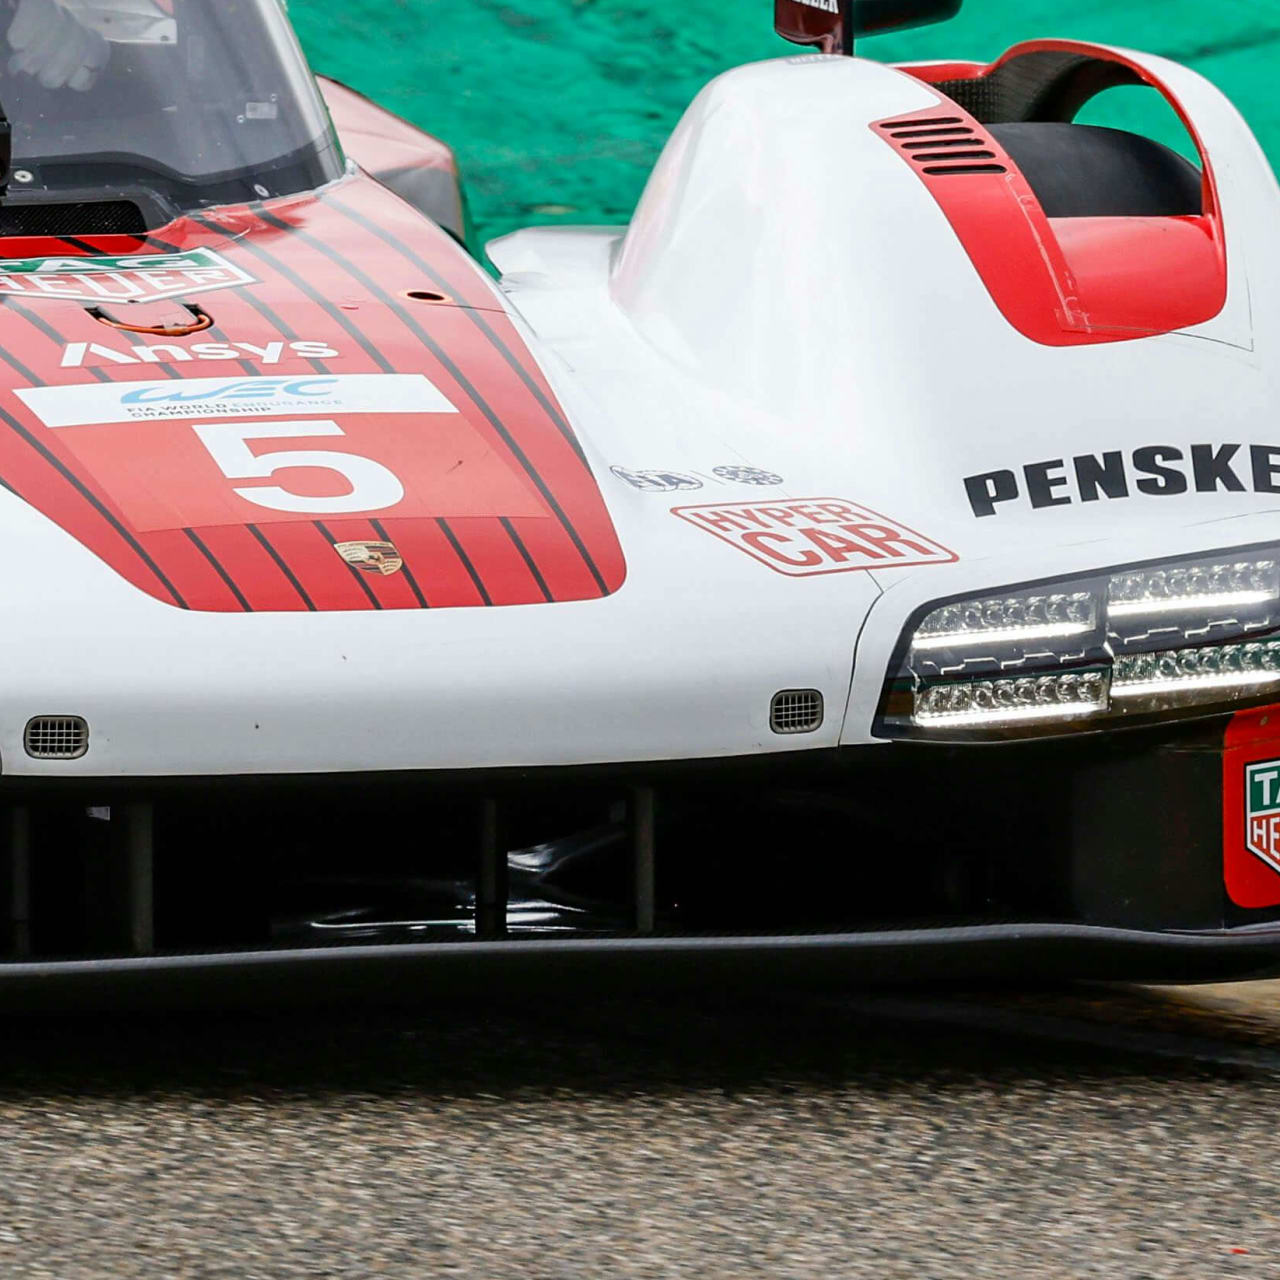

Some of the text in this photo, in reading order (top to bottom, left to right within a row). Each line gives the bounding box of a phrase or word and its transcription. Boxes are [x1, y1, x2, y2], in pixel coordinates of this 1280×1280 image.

[59, 341, 340, 368] Ansys
[120, 378, 339, 404] WEC
[131, 406, 272, 418] CHAMPIONSHIP
[160, 402, 228, 411] WORLD
[191, 420, 405, 514] 5
[692, 502, 871, 533] HYPER
[741, 523, 939, 568] CAR
